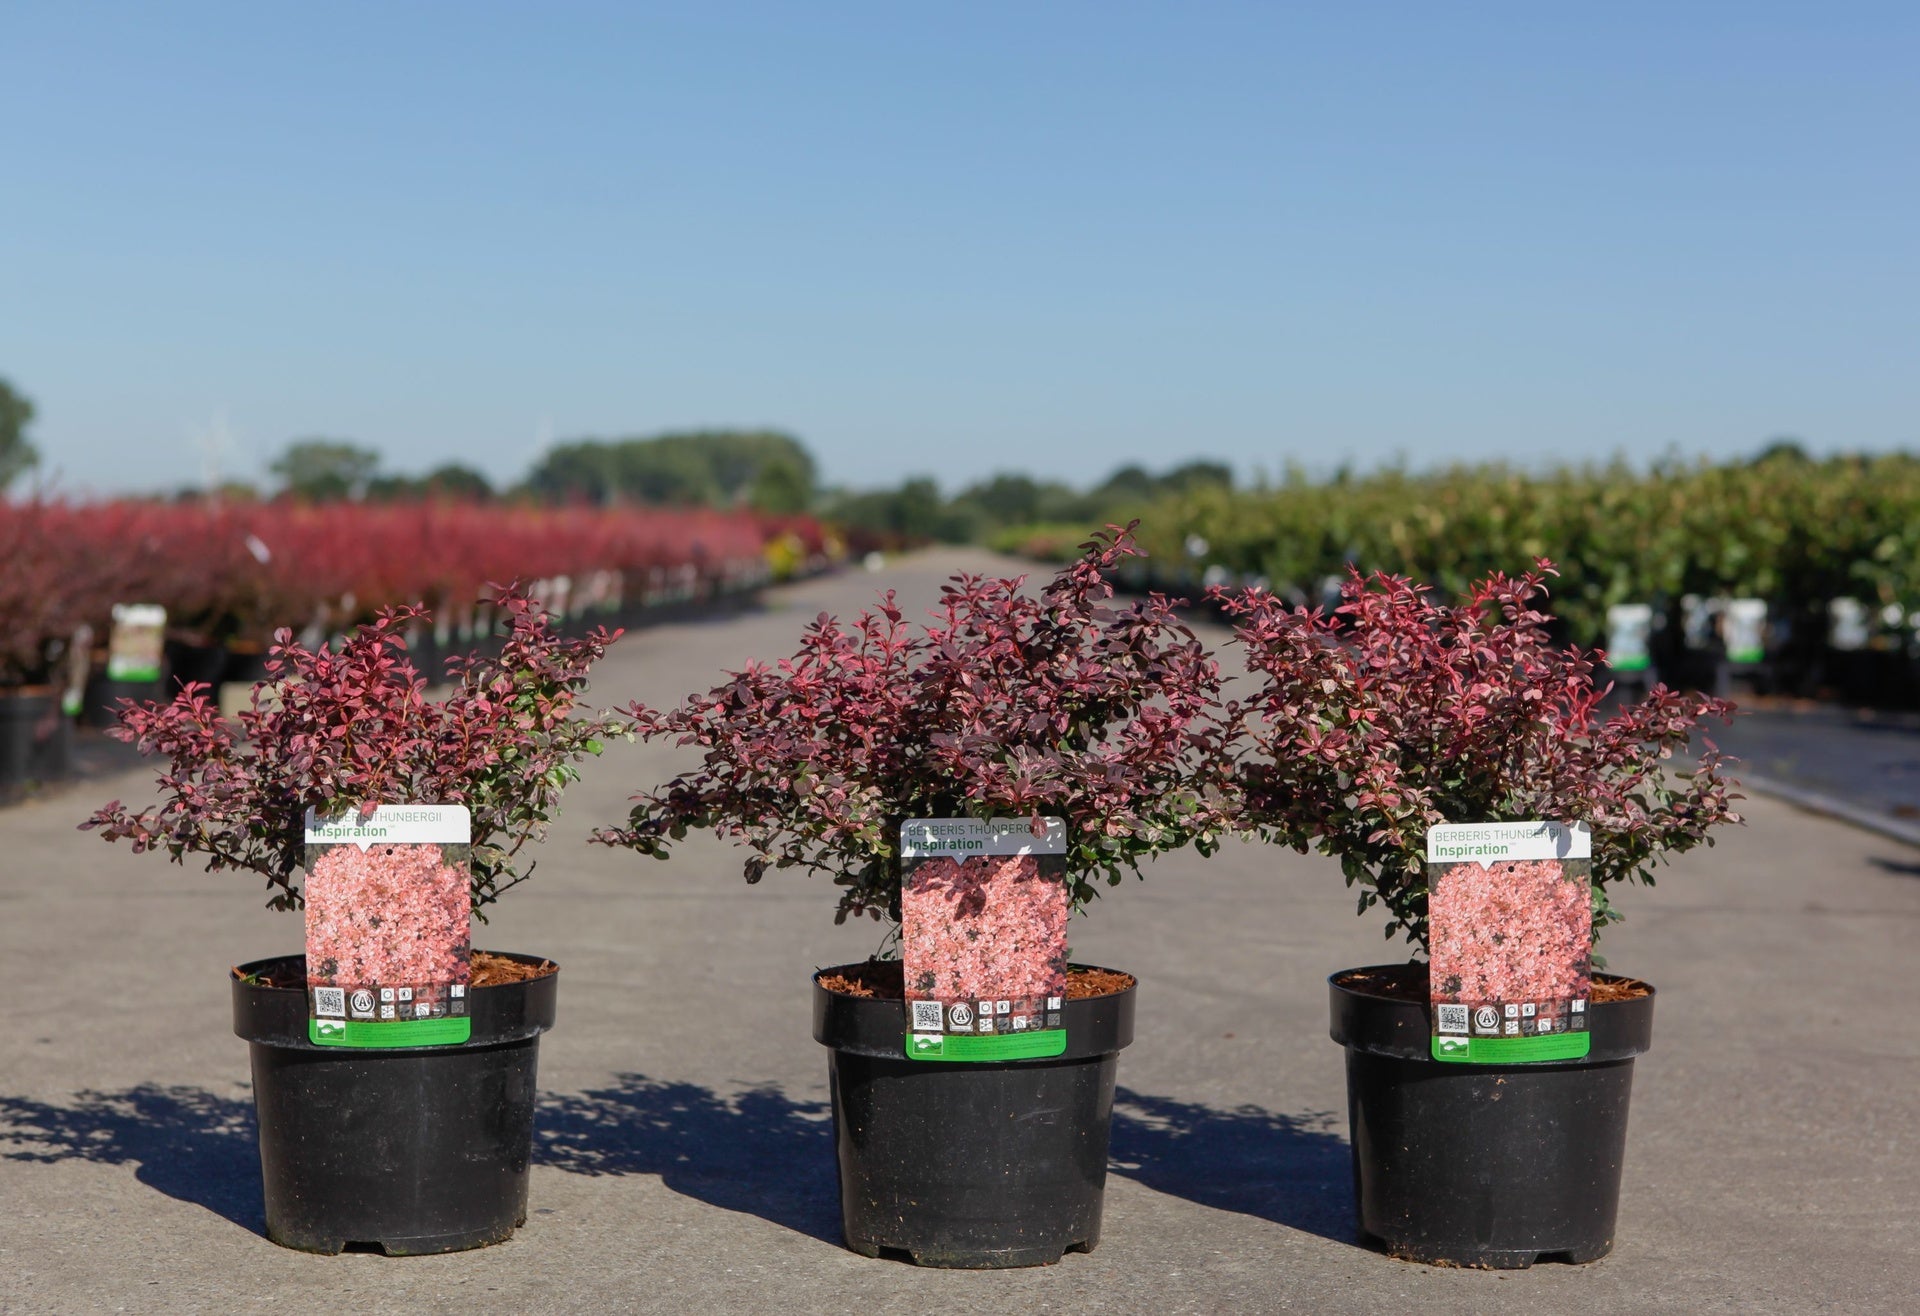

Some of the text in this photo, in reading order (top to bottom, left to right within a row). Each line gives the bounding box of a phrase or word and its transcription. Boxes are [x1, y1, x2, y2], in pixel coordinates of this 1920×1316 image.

[374, 812, 442, 822] THUNBERGII
[314, 825, 387, 839] Inspiration
[968, 823, 1032, 834] THUNBERG
[1435, 828, 1562, 842] BERBERIS THUNBERGII
[909, 837, 983, 852] Inspiration
[1435, 843, 1508, 858] Inspiration
